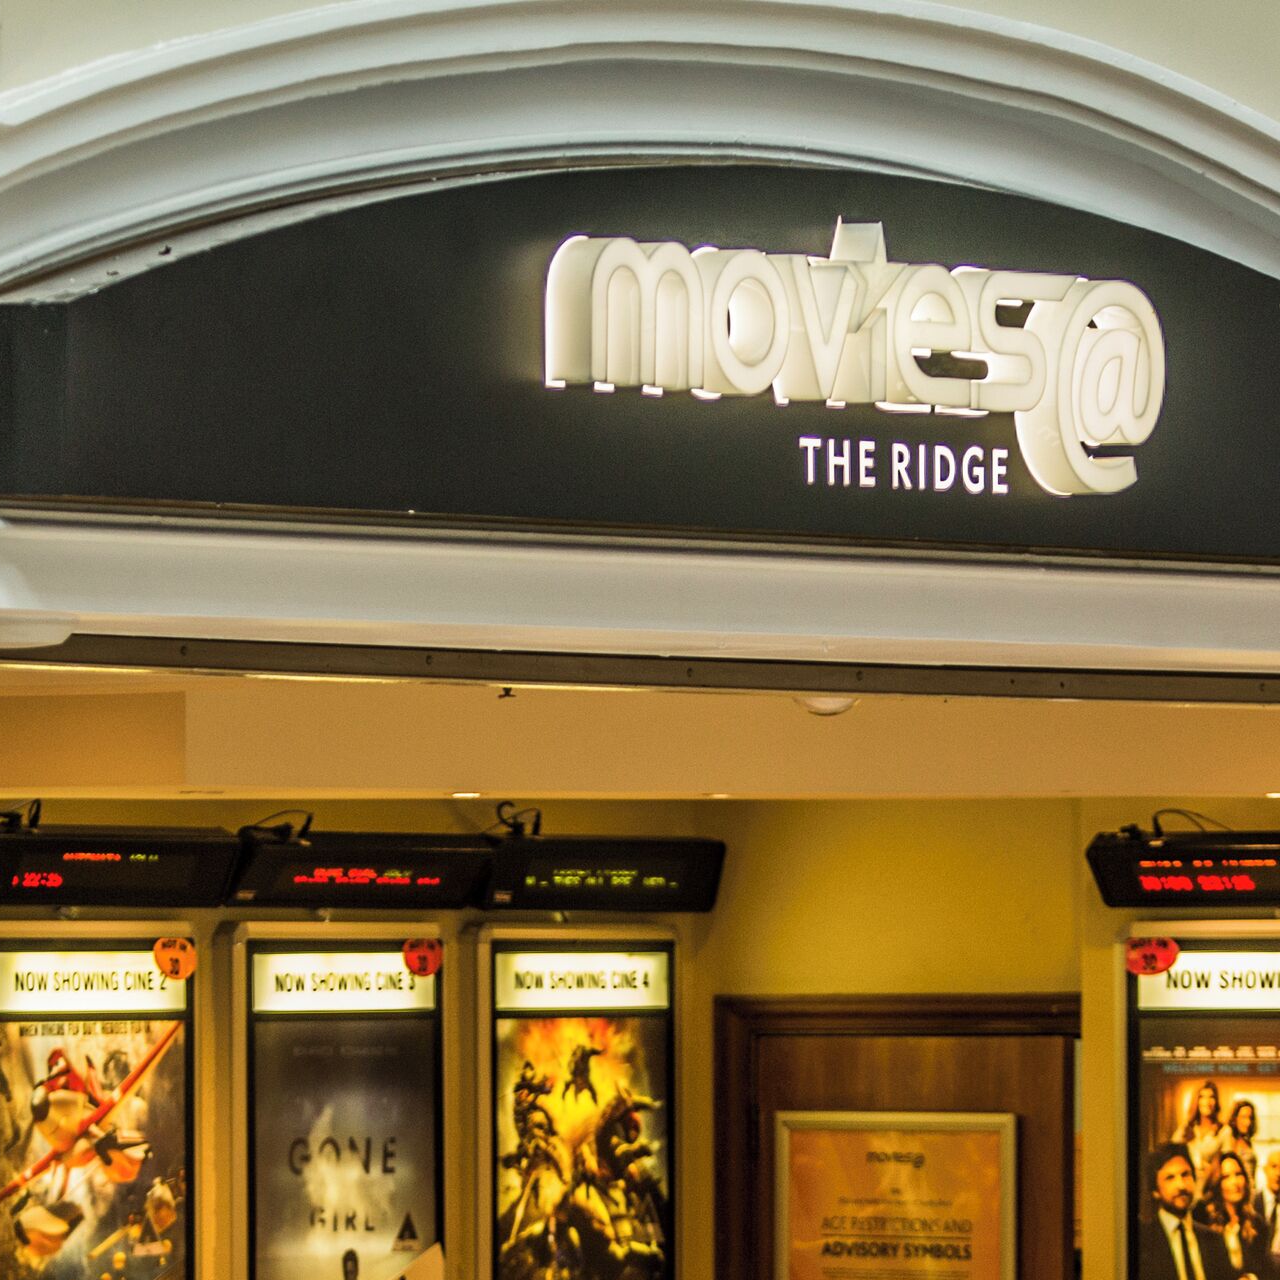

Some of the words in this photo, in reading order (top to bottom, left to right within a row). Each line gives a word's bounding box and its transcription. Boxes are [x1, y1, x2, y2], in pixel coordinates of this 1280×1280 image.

[544, 214, 1165, 497] movies@
[798, 435, 877, 488] THE
[889, 439, 1009, 496] RIDGE
[15, 971, 48, 991] NOW
[53, 971, 119, 991] SHOWING
[124, 971, 154, 990] CINE
[160, 972, 167, 990] 2
[275, 973, 305, 992] NOW
[311, 972, 370, 991] SHOWING
[376, 972, 403, 990] CINE
[409, 971, 416, 990] 3
[514, 971, 543, 989] NOW
[550, 971, 606, 989] SHOWING
[612, 971, 637, 989] CINE
[642, 972, 649, 988] 4
[1166, 970, 1212, 989] NOW
[287, 1136, 398, 1176] GONE
[309, 1207, 377, 1233] GIRL
[821, 1241, 899, 1258] ADVISORY
[903, 1243, 972, 1260] SYMBOLS
